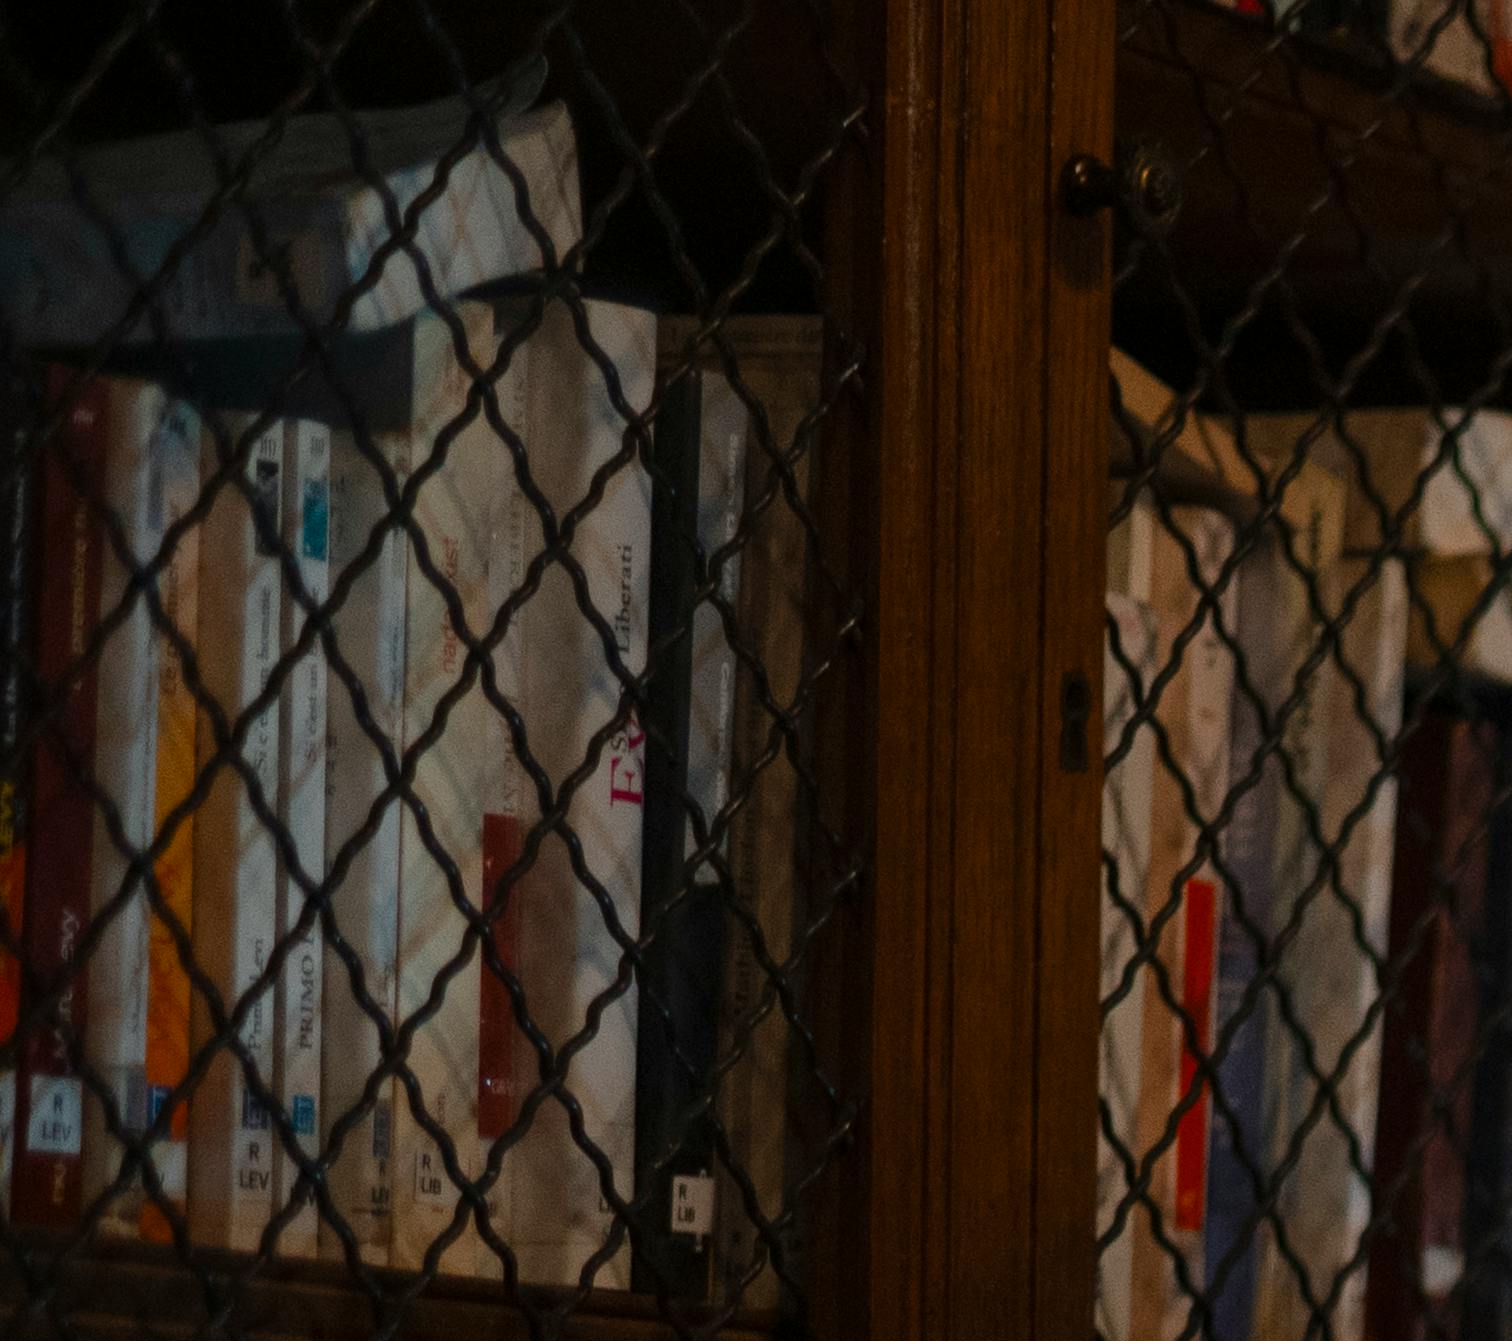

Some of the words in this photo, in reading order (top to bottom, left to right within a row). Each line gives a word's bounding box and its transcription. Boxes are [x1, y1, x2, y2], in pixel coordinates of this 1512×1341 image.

[612, 543, 633, 654] Liberati
[298, 955, 315, 1049] PRIMO
[53, 1093, 63, 1114] R
[41, 1120, 72, 1142] LEV
[248, 1142, 260, 1160] R
[422, 1154, 431, 1169] R
[239, 1170, 270, 1190] LEV
[420, 1178, 442, 1195] LIB
[679, 1184, 687, 1200] R
[677, 1207, 696, 1223] LIB
